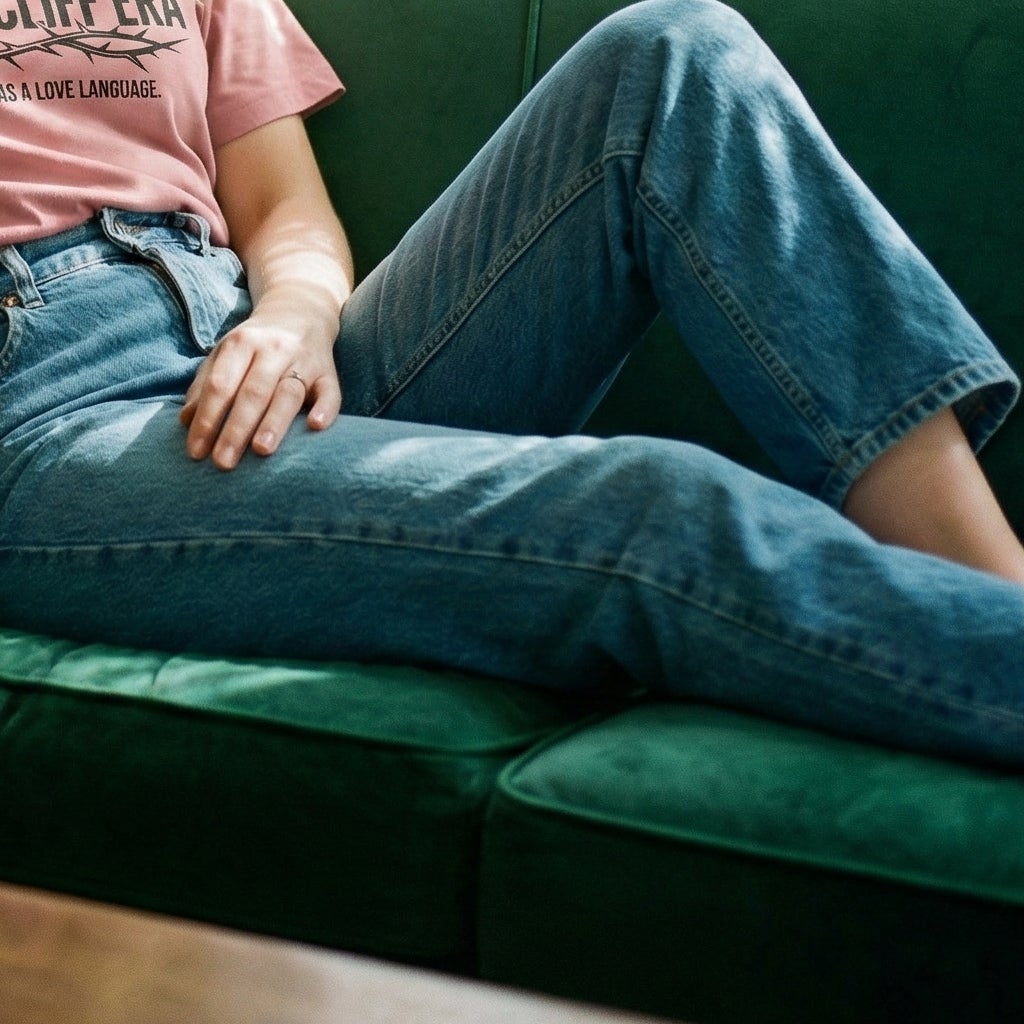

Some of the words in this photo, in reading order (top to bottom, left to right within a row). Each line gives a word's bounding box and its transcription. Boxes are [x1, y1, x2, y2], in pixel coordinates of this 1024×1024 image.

[21, 82, 32, 101] A
[35, 79, 75, 100] LOVE
[78, 79, 162, 99] LANGUAGE.
